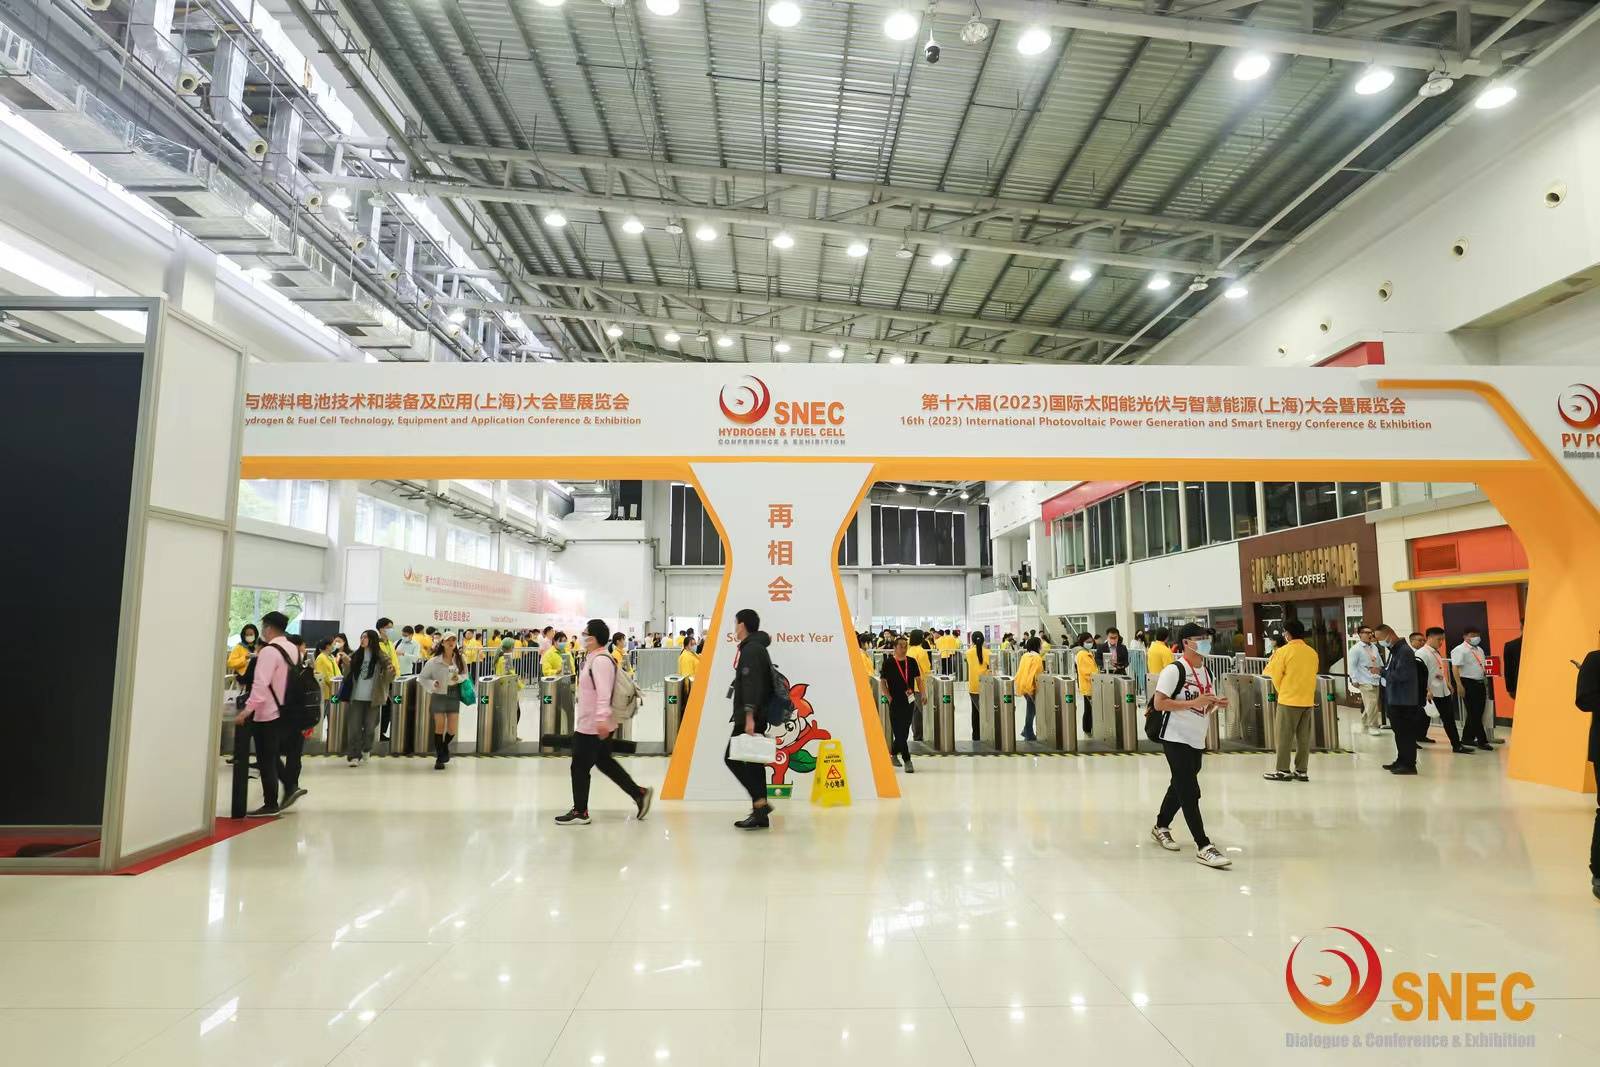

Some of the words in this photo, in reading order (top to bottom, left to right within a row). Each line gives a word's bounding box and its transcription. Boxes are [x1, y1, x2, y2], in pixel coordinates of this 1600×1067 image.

[246, 392, 630, 411] 与燃料电池技术和装备及应用(上海)大会暨展览会
[921, 393, 1406, 414] 第十六届(2023)国际太阳能光伏与智慧能源(上海)大会暨展览会
[774, 401, 845, 425] SNEC
[246, 415, 284, 426] ydrogen
[286, 416, 295, 425] &
[298, 415, 317, 425] Fuel
[319, 415, 337, 425] Cell
[340, 415, 394, 427] Technology,
[398, 416, 448, 427] Equipment
[450, 416, 468, 425] and
[471, 415, 525, 427] Application
[528, 415, 581, 425] Conference
[583, 416, 592, 425] &
[594, 415, 642, 425] Exhibition
[900, 415, 925, 426] 16th
[928, 415, 963, 427] (2023)
[966, 416, 1036, 427] International
[1039, 416, 1107, 427] Photovoltaic
[1109, 417, 1144, 428] Power
[1146, 417, 1206, 429] Generation
[1208, 418, 1229, 429] and
[1231, 418, 1264, 429] Smart
[1266, 418, 1301, 431] Energy
[1304, 418, 1365, 430] Conference
[1367, 419, 1377, 430] &
[1379, 419, 1433, 430] Exhibition
[718, 428, 776, 438] HYDROGEN
[779, 428, 787, 438] &
[790, 428, 817, 438] FUEL
[819, 428, 846, 438] CELL
[1561, 433, 1582, 448] PV
[767, 503, 794, 602] 再相会
[1277, 576, 1295, 586] TREE
[1298, 573, 1326, 585] COFFEE
[776, 632, 805, 643] Next
[808, 632, 834, 643] Year
